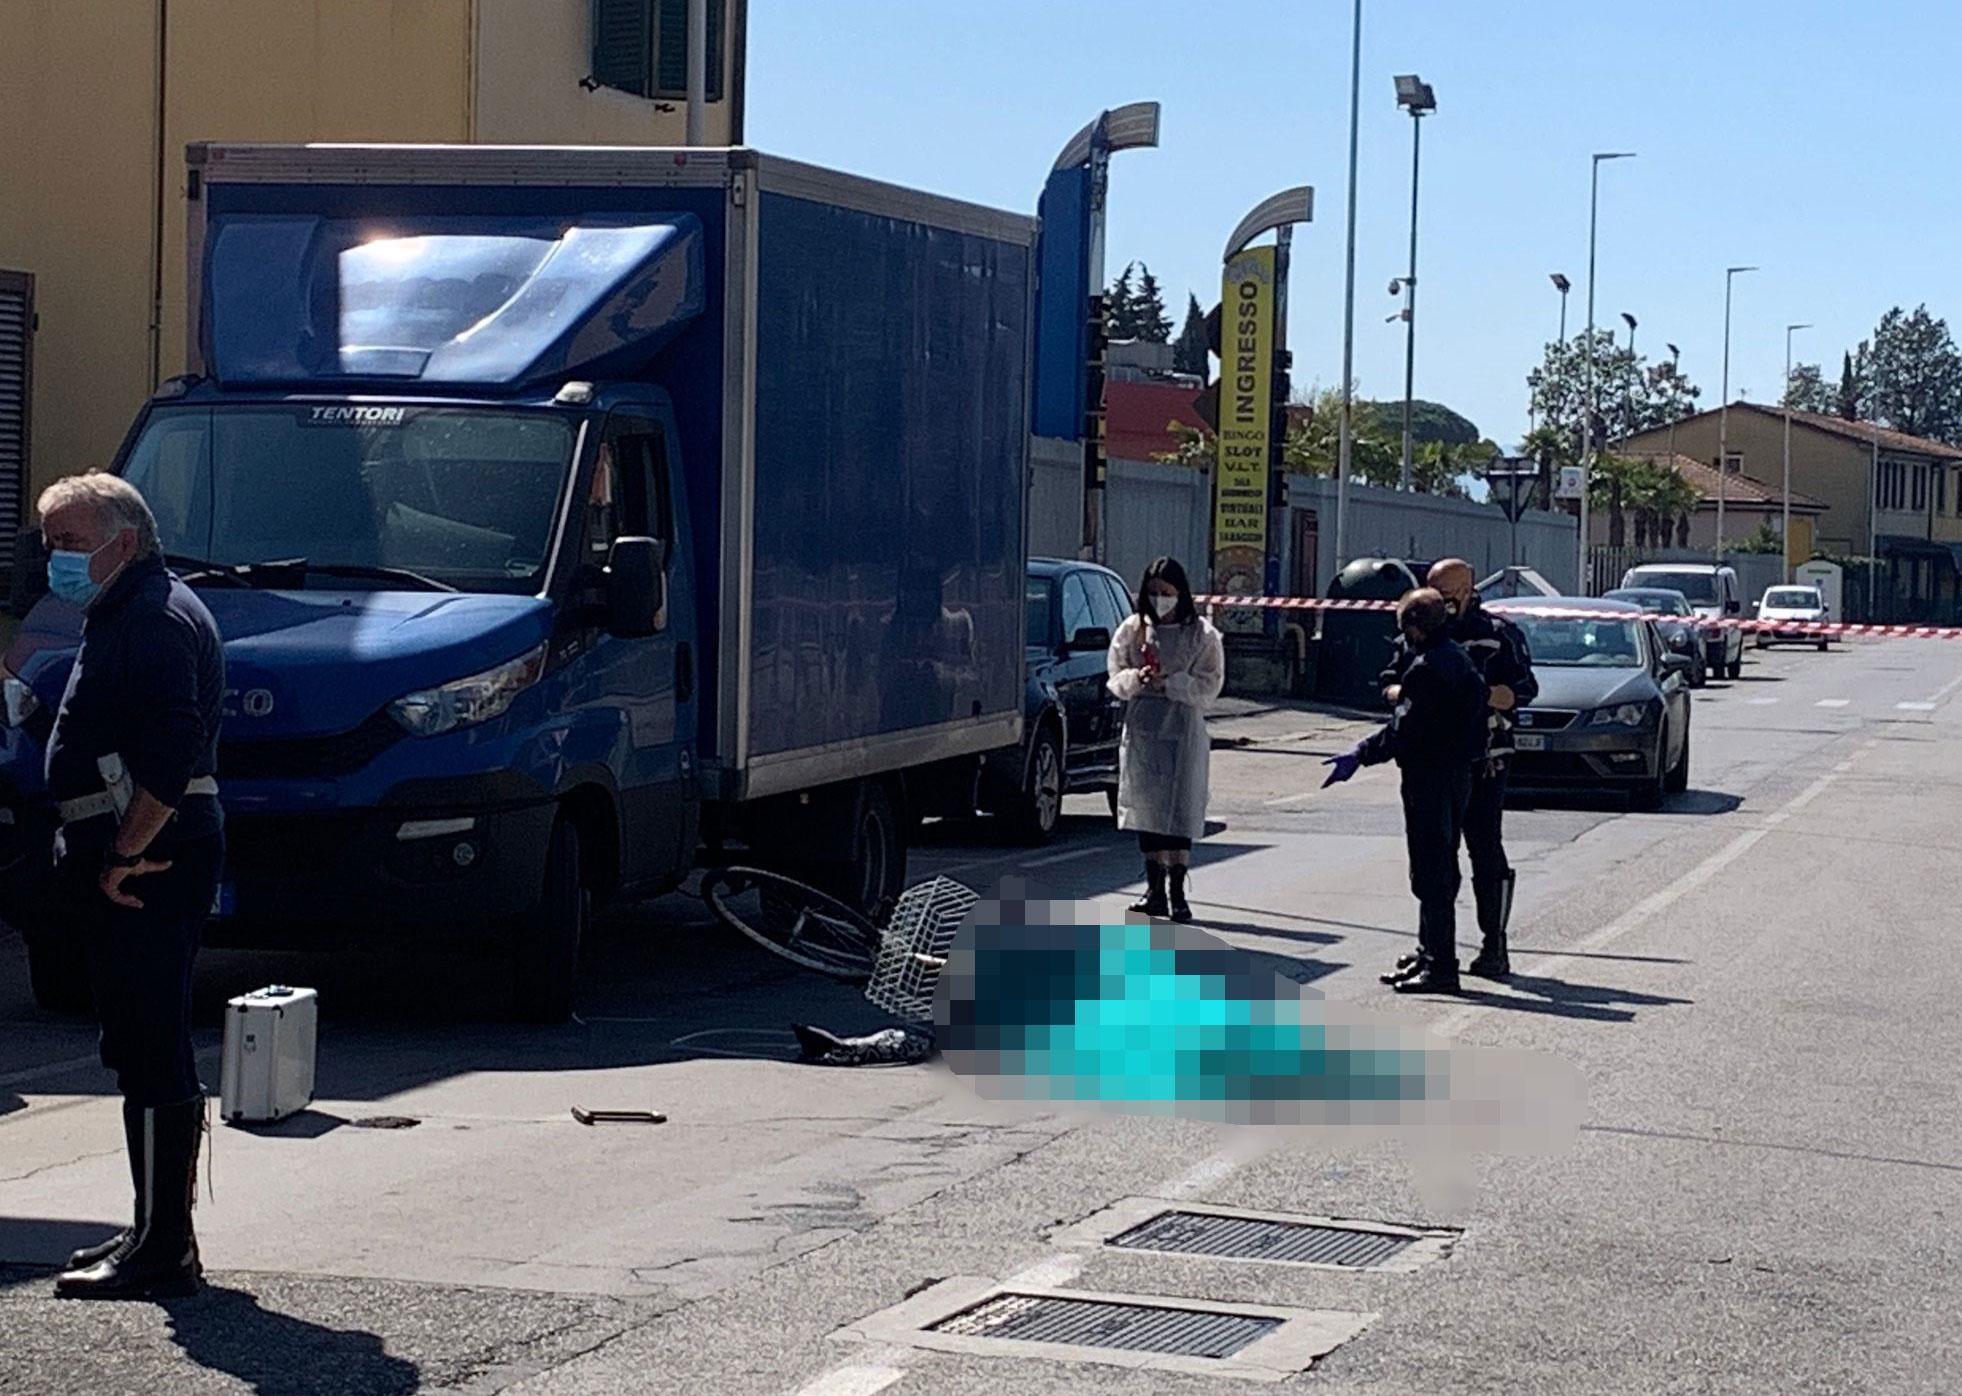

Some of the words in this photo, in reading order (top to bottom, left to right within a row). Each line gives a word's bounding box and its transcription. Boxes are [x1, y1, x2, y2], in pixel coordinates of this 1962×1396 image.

[1236, 280, 1258, 422] INGRESSO
[311, 406, 405, 420] TENTORI
[1224, 446, 1263, 457] SLOT
[1225, 518, 1259, 528] BAR
